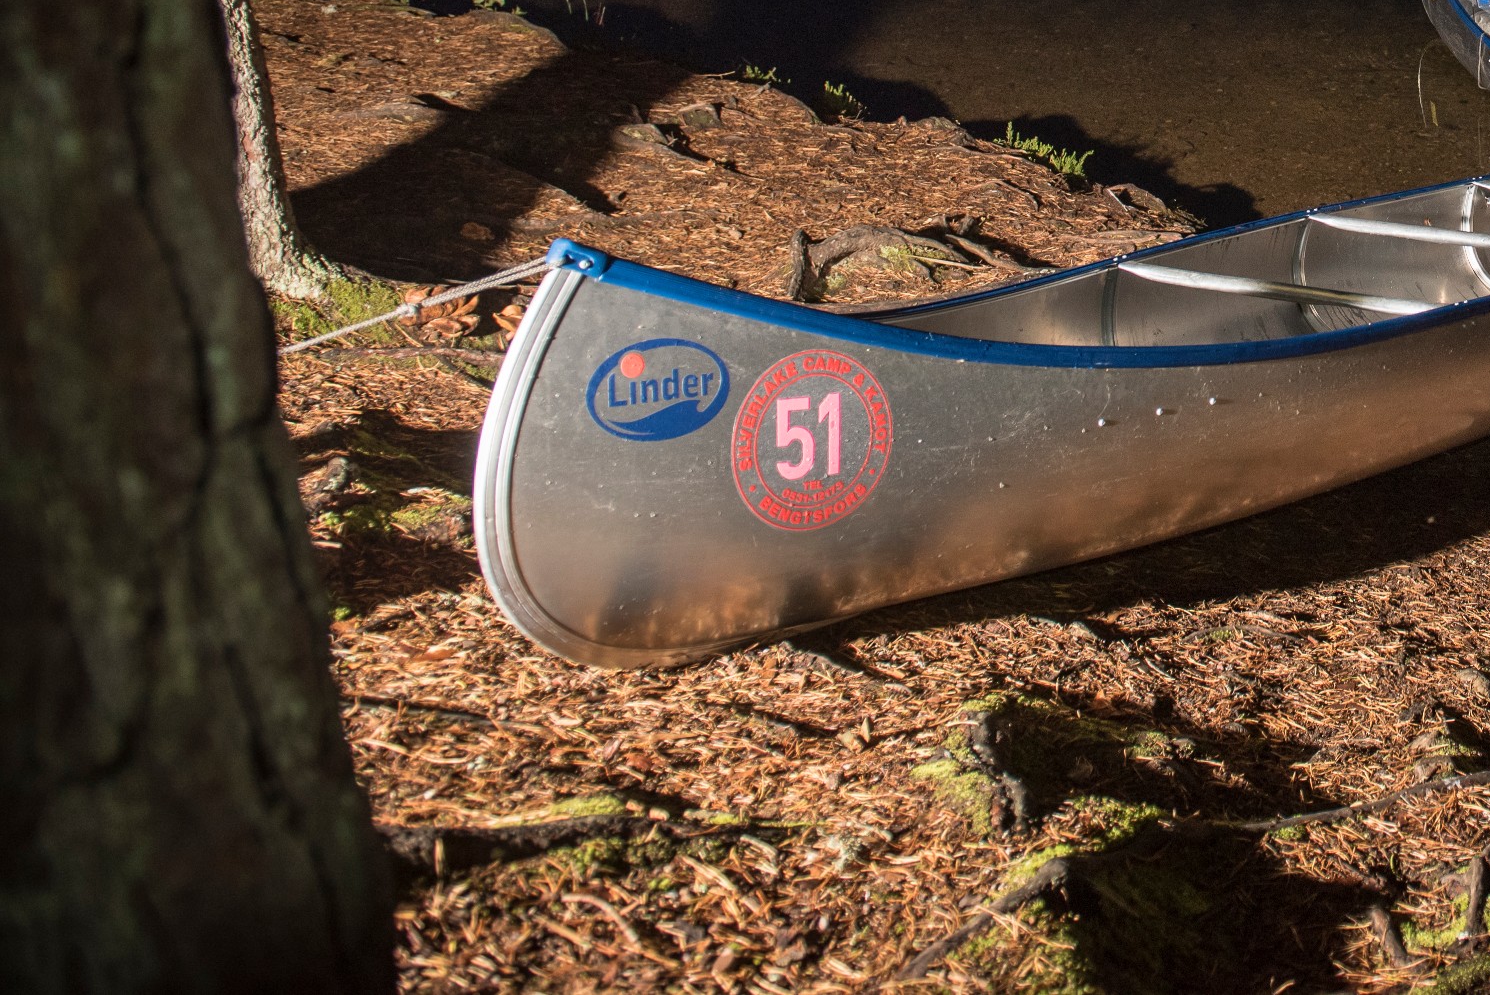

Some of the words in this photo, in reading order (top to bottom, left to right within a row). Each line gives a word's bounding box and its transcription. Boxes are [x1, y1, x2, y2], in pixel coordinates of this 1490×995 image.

[607, 360, 715, 408] Linder
[738, 362, 798, 471] SILVERLAKE
[802, 356, 852, 375] CAMP
[853, 372, 865, 388] &
[864, 385, 888, 454] KANOT
[776, 392, 842, 480] 51
[758, 483, 868, 525] BENGTSFORS
[803, 480, 823, 490] TEL
